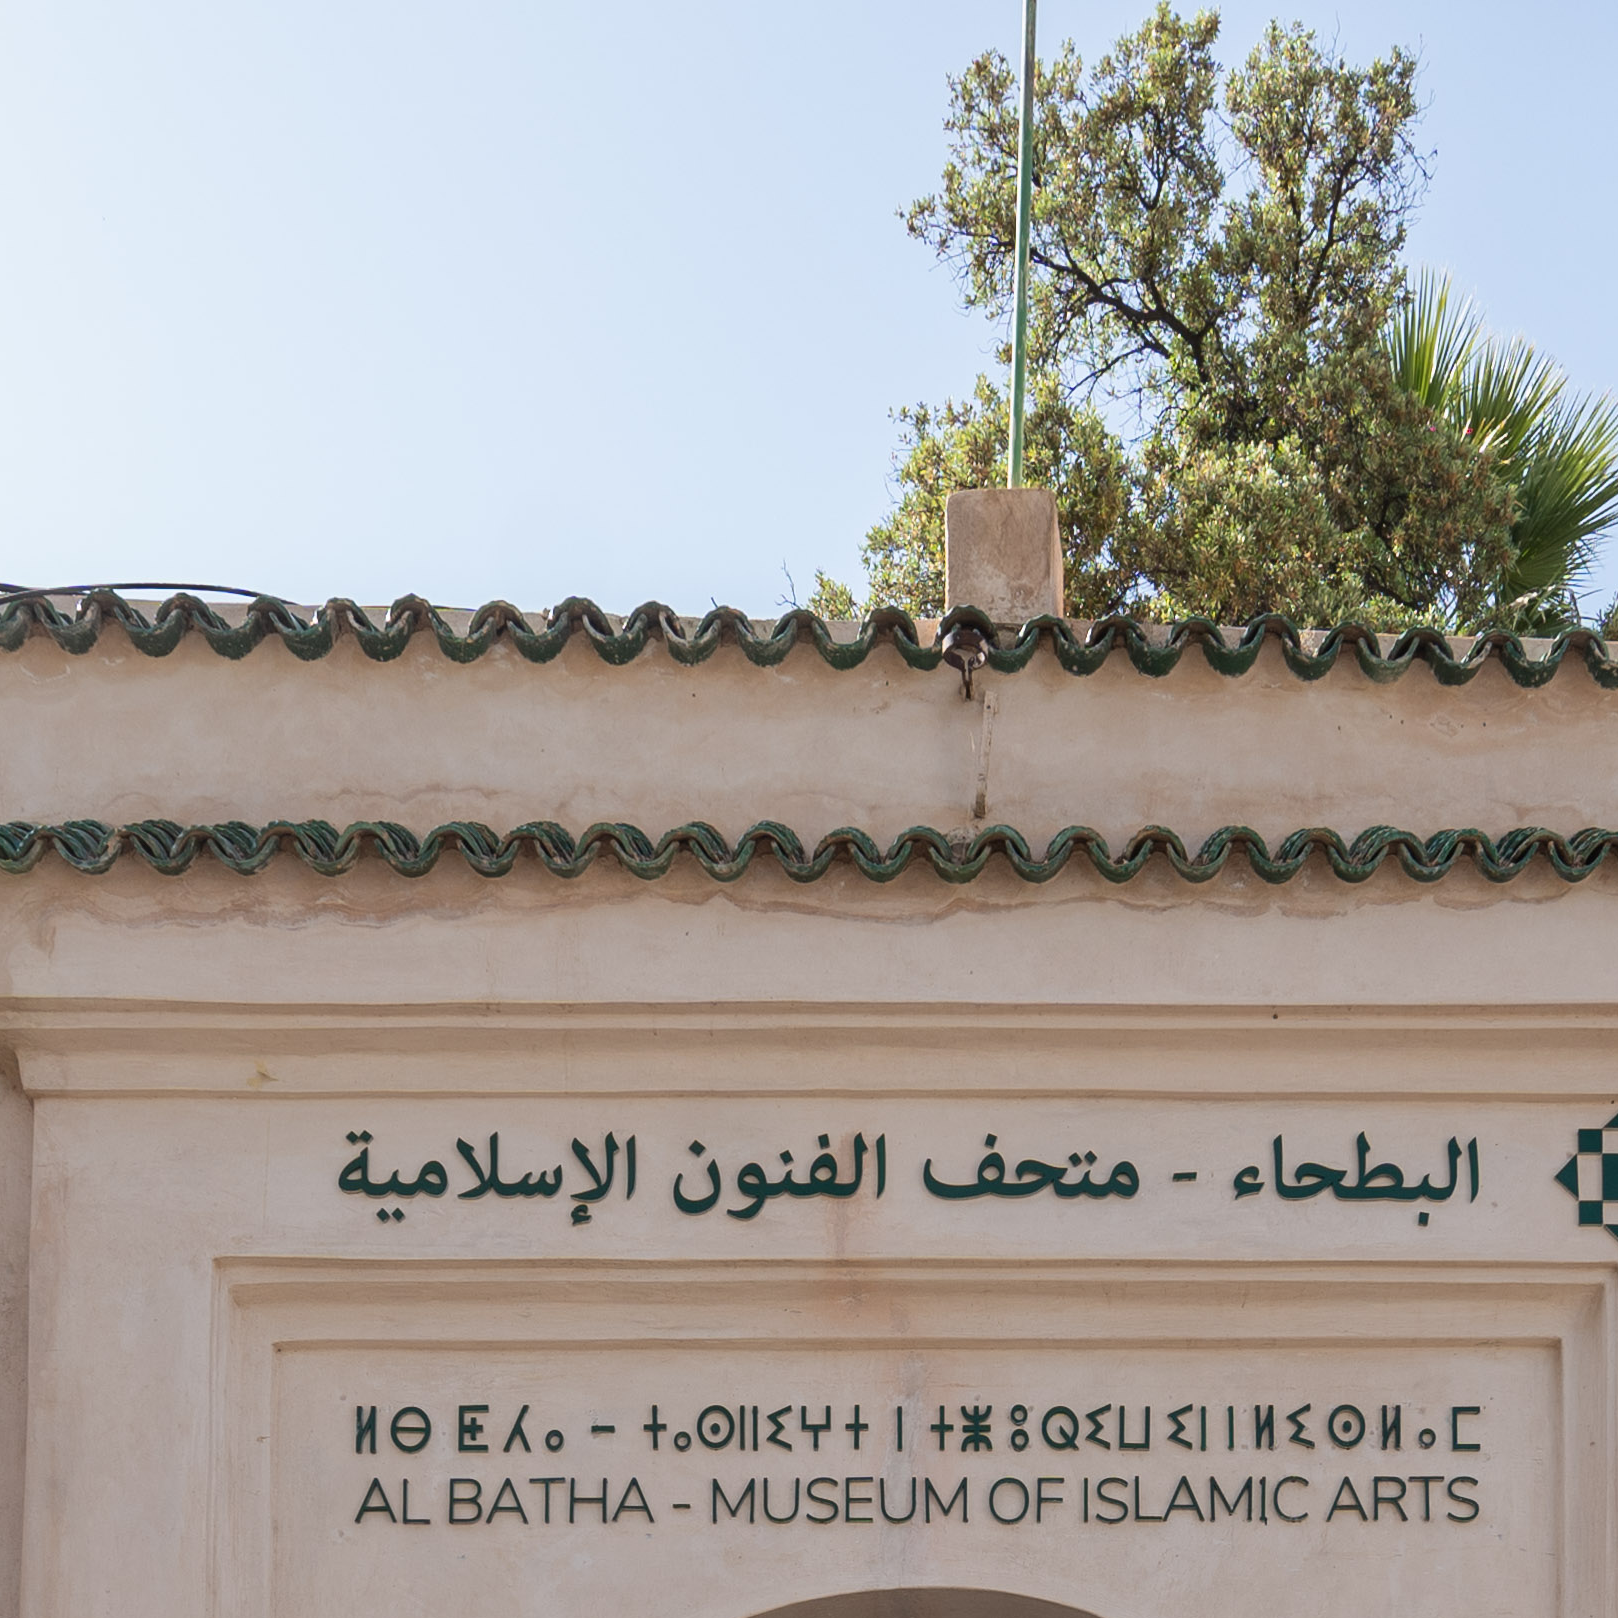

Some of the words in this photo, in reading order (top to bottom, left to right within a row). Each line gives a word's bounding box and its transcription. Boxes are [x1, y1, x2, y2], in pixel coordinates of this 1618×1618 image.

[337, 1130, 637, 1226] الإسلامية
[672, 1132, 886, 1220] الفنون
[923, 1131, 1140, 1200] متحف
[1232, 1130, 1481, 1226] البطحاء
[355, 1478, 430, 1525] AL
[448, 1477, 655, 1525] BATHA
[712, 1476, 968, 1524] MUSEUM
[988, 1476, 1065, 1524] OF
[1083, 1475, 1310, 1524] ISLAMIC
[1326, 1475, 1481, 1523] ARTS
